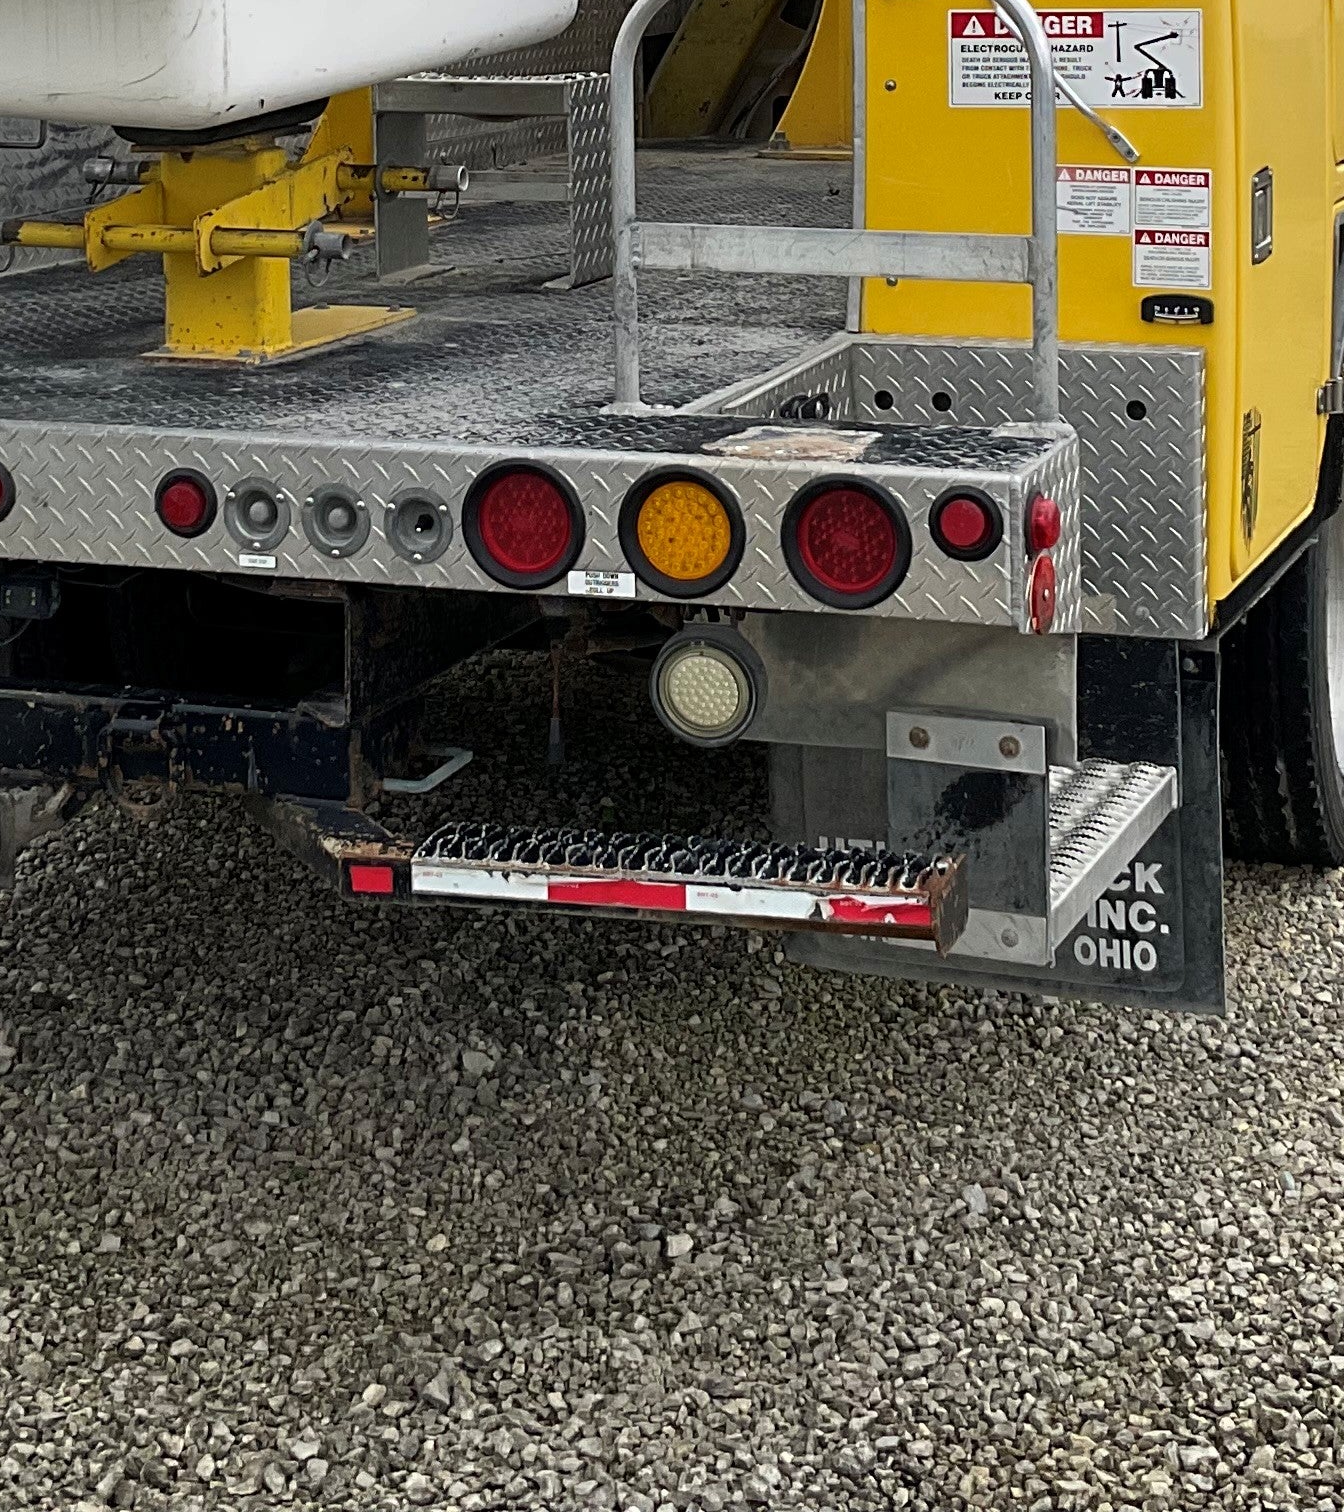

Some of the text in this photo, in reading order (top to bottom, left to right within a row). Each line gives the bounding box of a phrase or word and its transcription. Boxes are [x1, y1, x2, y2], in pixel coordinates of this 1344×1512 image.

[960, 44, 1094, 53] ELECTROCU HAZARD
[994, 92, 1023, 100] KEEP
[1075, 169, 1129, 182] DANGER
[1154, 173, 1205, 186] DANGER
[1154, 232, 1206, 245] DANGER
[1087, 899, 1170, 935] INC.
[1073, 934, 1158, 972] OHIO
